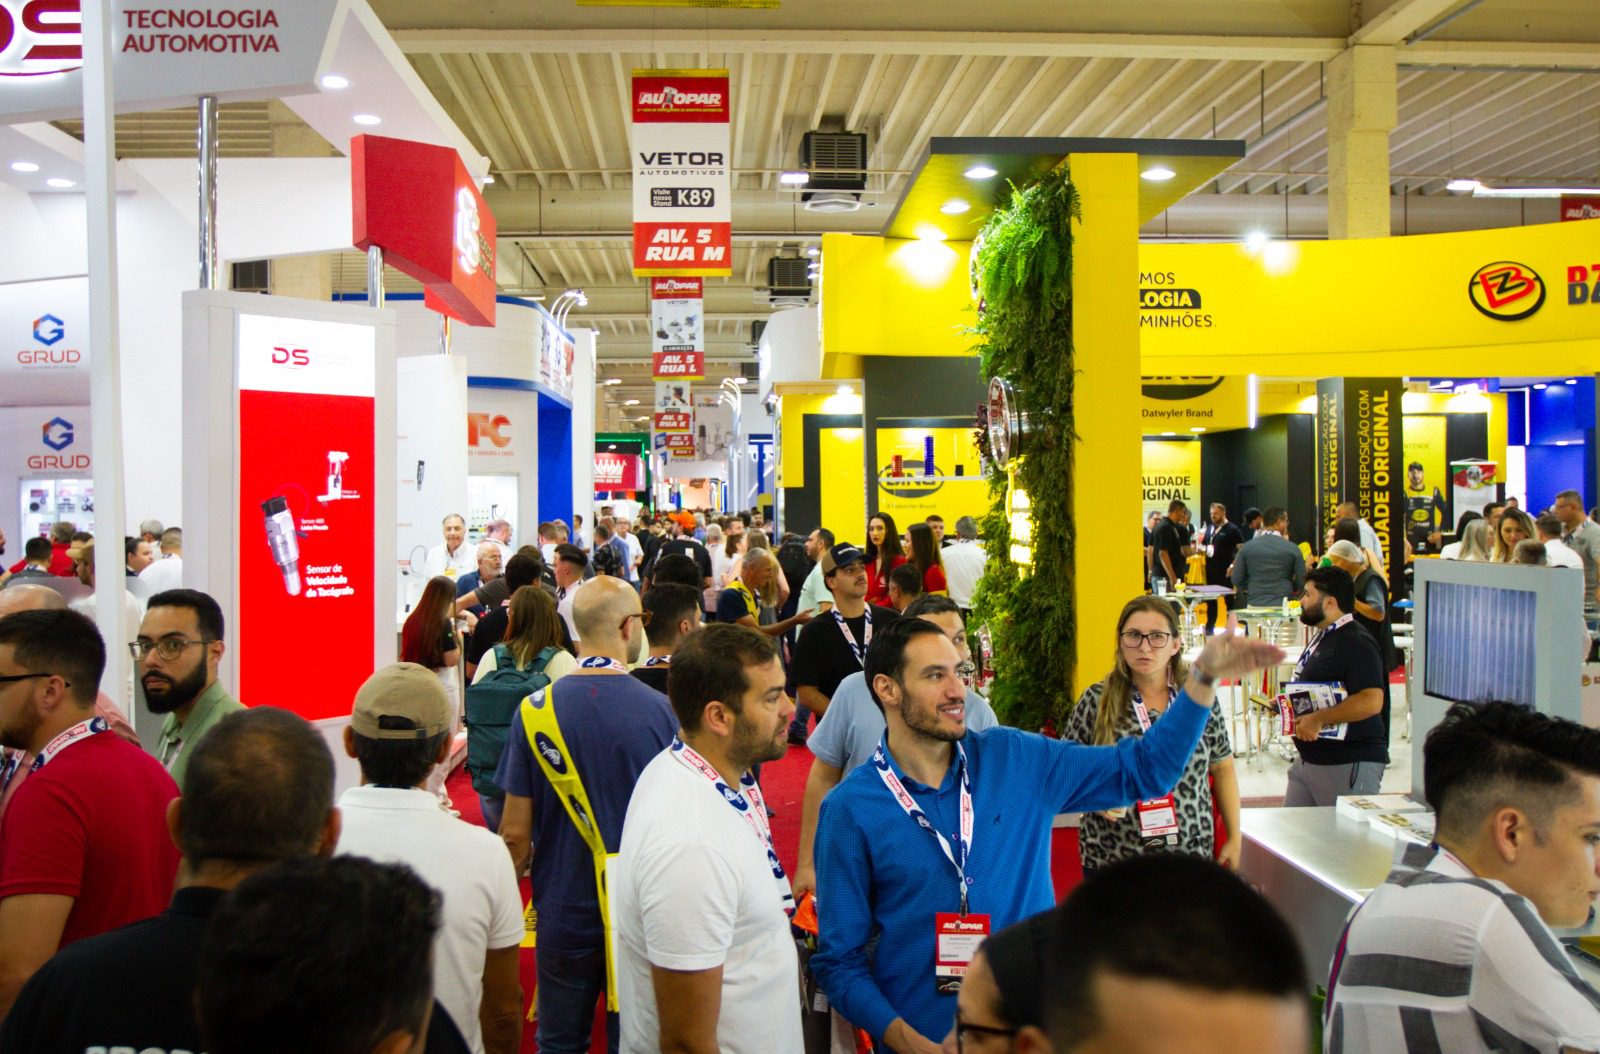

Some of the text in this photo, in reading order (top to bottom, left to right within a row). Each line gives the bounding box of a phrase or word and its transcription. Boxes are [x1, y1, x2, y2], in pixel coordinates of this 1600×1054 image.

[123, 9, 279, 28] TECNOLOGIA
[122, 34, 280, 53] AUTOMOTIVA
[638, 87, 722, 108] AUTOPAR
[640, 152, 724, 165] VETOR
[677, 189, 712, 206] K89
[652, 229, 712, 244] AV. 5
[645, 246, 726, 261] RUA M
[1139, 272, 1175, 285] MOS
[17, 350, 81, 364] GRUD
[271, 346, 310, 366] DS
[662, 355, 695, 364] AV. 5
[659, 364, 697, 373] RUA L
[1358, 390, 1371, 418] COM
[1141, 408, 1213, 419] Datwyler Brand
[1329, 391, 1338, 488] ORIGINAL
[1373, 389, 1390, 487] ORIGINAL
[1357, 420, 1372, 488] REPOSIÇÃO
[28, 455, 90, 469] GRUD
[1142, 488, 1191, 500] IGINAL
[1359, 490, 1371, 507] DE
[306, 563, 342, 574] Sensor de
[306, 575, 348, 586] Velocidade
